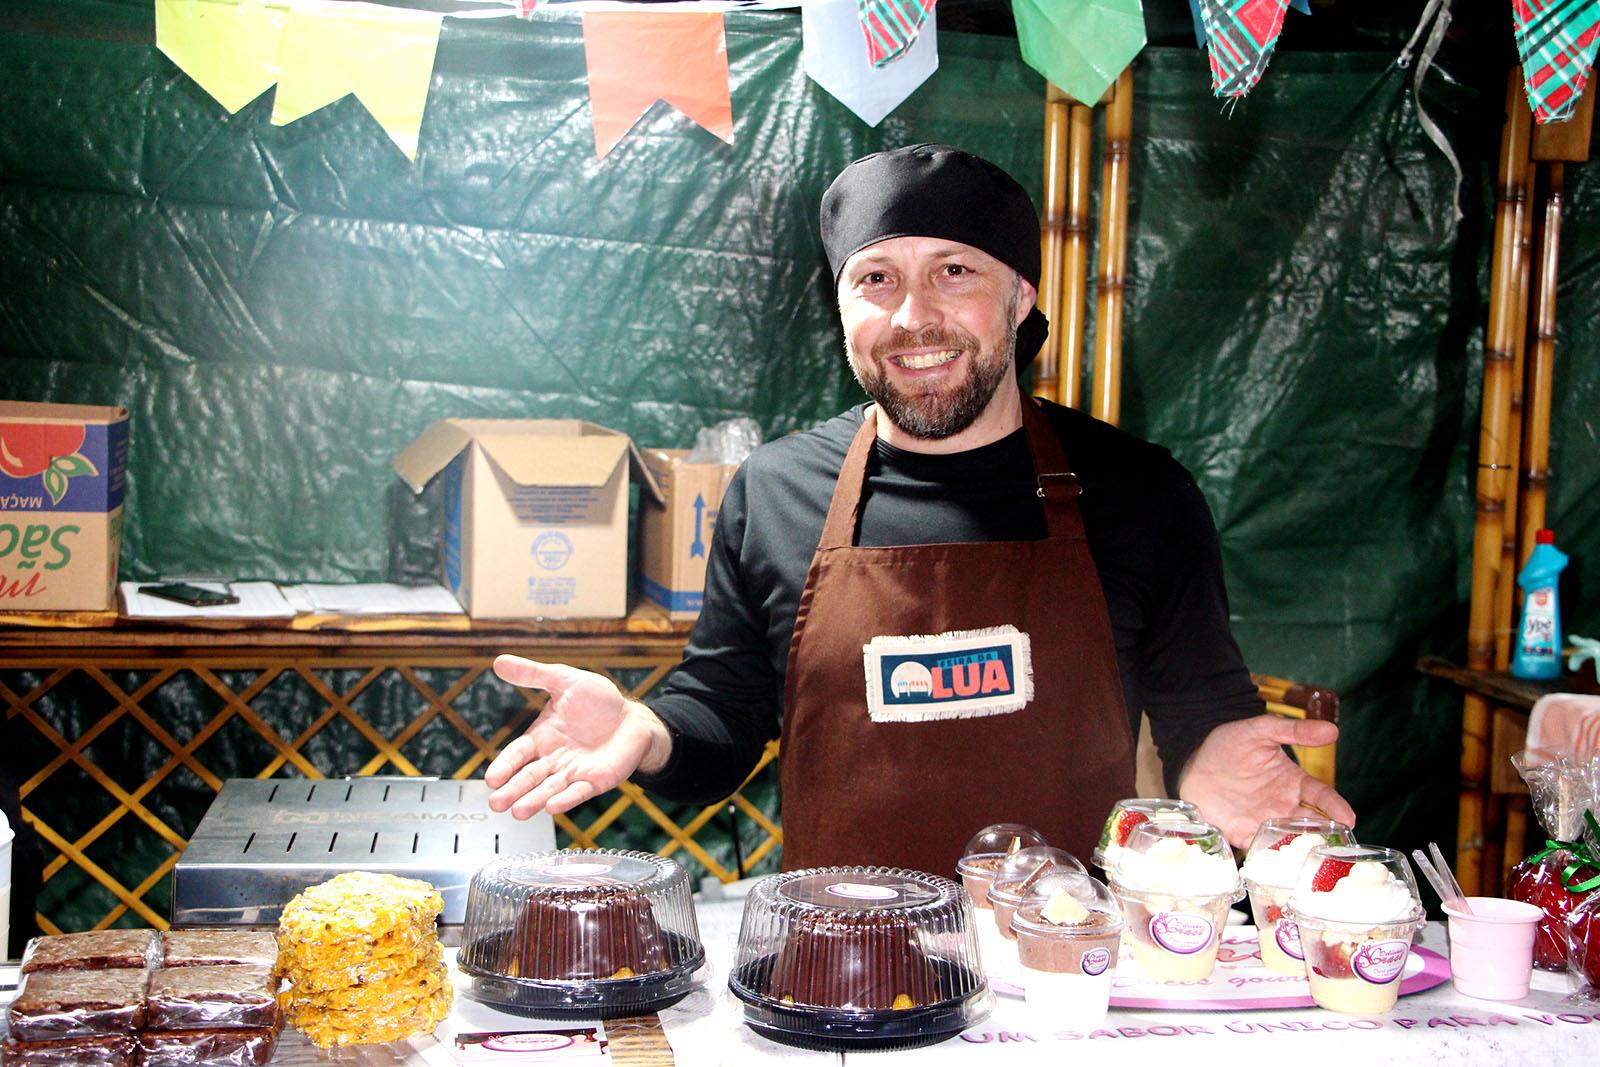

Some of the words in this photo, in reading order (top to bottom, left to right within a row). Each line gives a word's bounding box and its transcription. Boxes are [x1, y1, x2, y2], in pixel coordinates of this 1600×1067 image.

[940, 656, 973, 668] FEIRA
[979, 652, 992, 662] DA
[931, 660, 1010, 698] LUA
[961, 1029, 1036, 1043] UM
[1055, 1023, 1216, 1041] SABOR
[1224, 1018, 1385, 1034] ÚNICO
[1395, 1014, 1518, 1029] PARA
